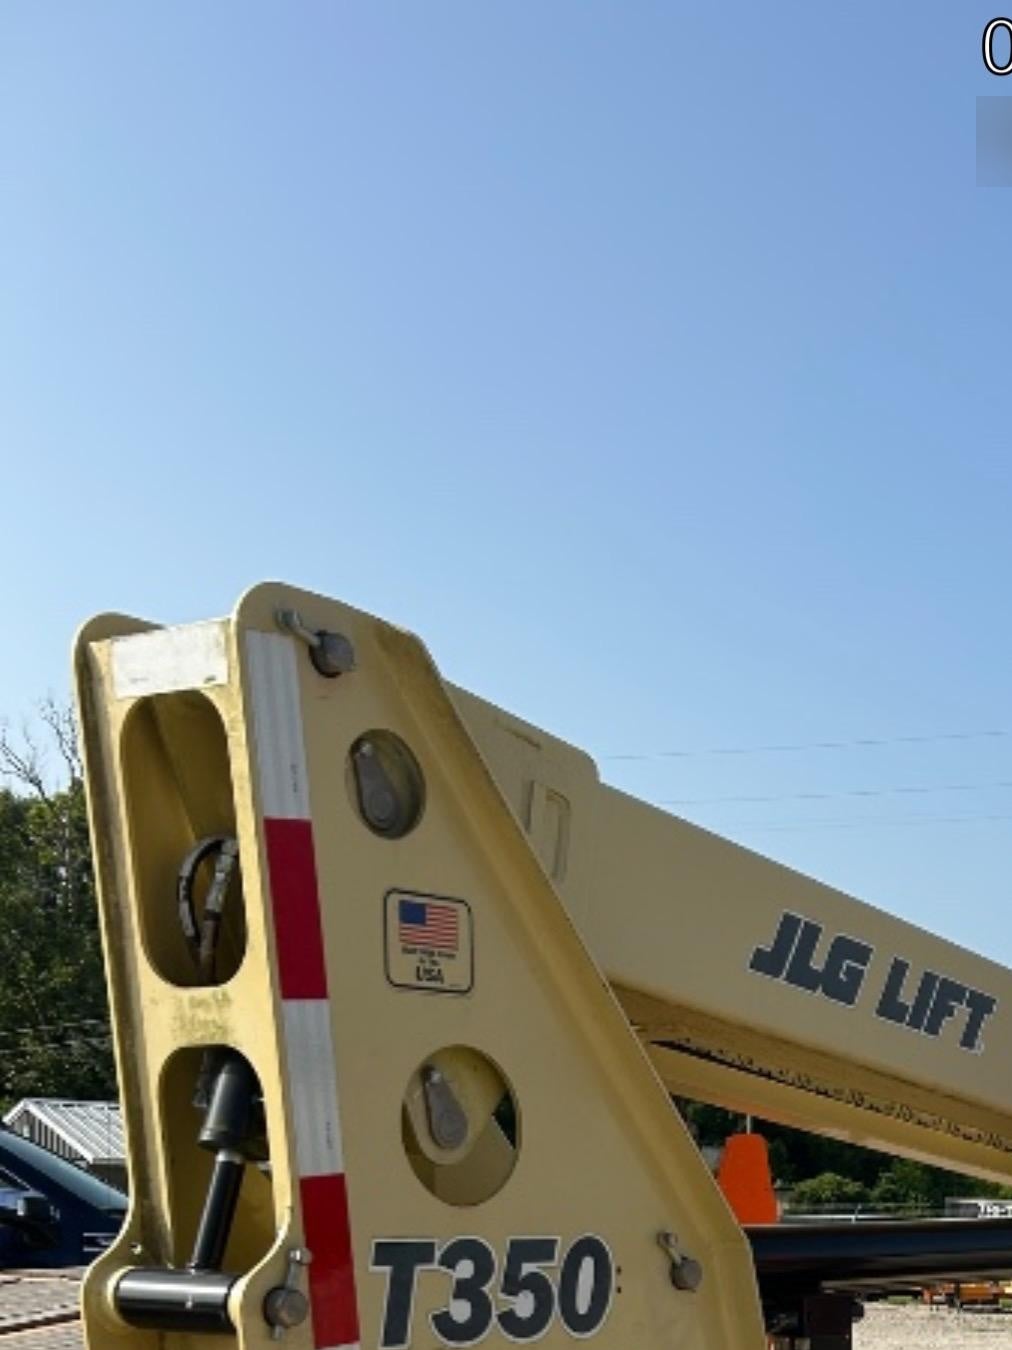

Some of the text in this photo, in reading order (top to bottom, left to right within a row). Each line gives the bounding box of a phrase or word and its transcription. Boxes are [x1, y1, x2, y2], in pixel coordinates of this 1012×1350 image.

[748, 909, 998, 1055] JLG LIFT
[368, 1232, 615, 1350] T350
